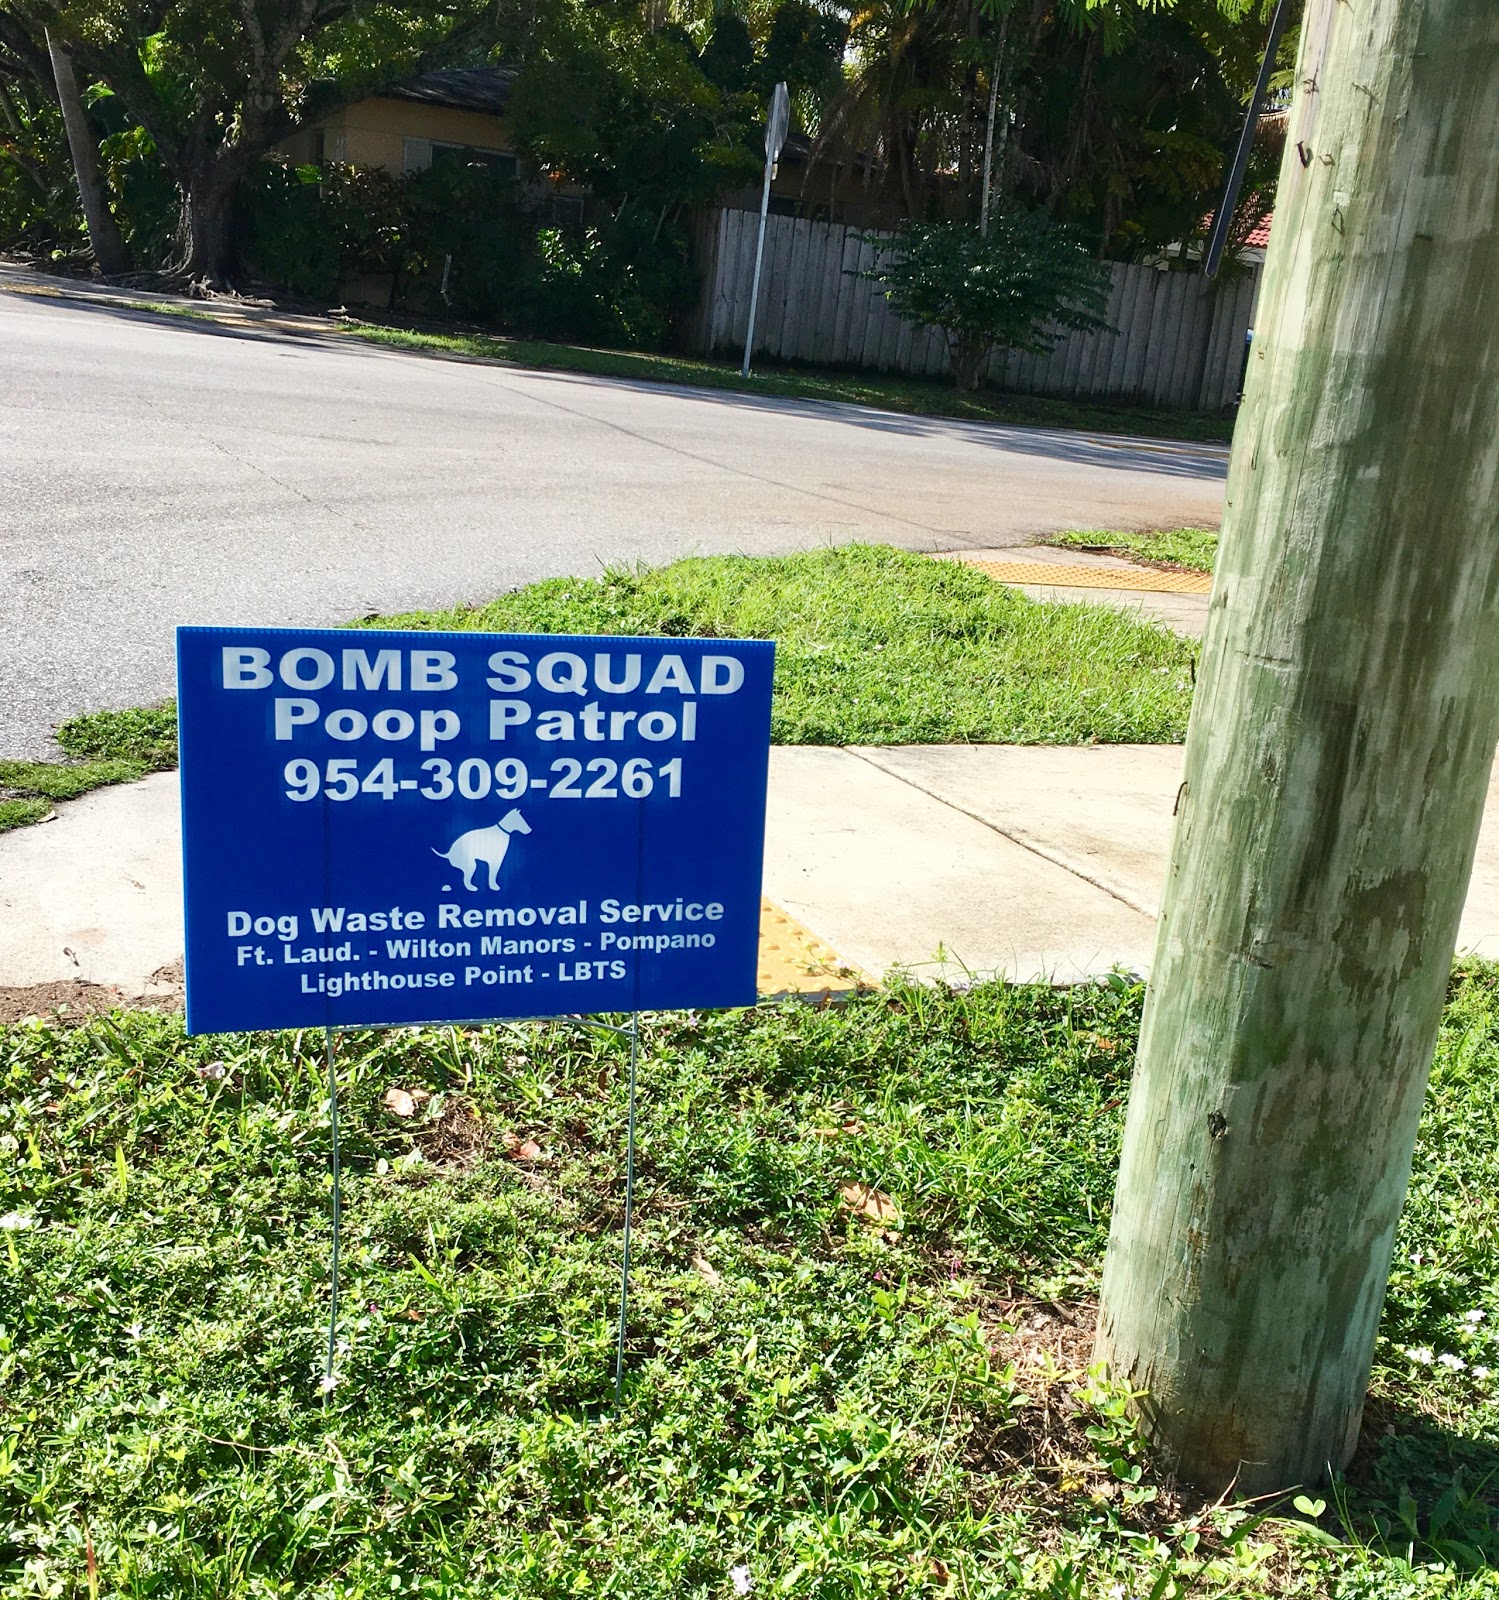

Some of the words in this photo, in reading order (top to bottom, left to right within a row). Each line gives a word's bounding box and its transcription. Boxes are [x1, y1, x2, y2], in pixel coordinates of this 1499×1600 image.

[222, 646, 458, 691] BOMB
[486, 651, 745, 697] SQUAD
[274, 698, 461, 751] Poop
[489, 699, 697, 741] Patrol
[284, 757, 682, 802] 954-309-2261
[227, 911, 298, 942] Dog
[310, 906, 426, 933] Waste
[438, 900, 587, 929] Removal
[599, 898, 724, 924] Service
[237, 945, 274, 966] Ft.
[284, 941, 360, 964] Laud.
[385, 938, 471, 959] Wilton
[481, 936, 576, 956] Manors
[600, 931, 715, 954] Pompano
[301, 969, 455, 997] Lighthouse
[465, 965, 533, 986] Point
[559, 960, 626, 982] LBTS
